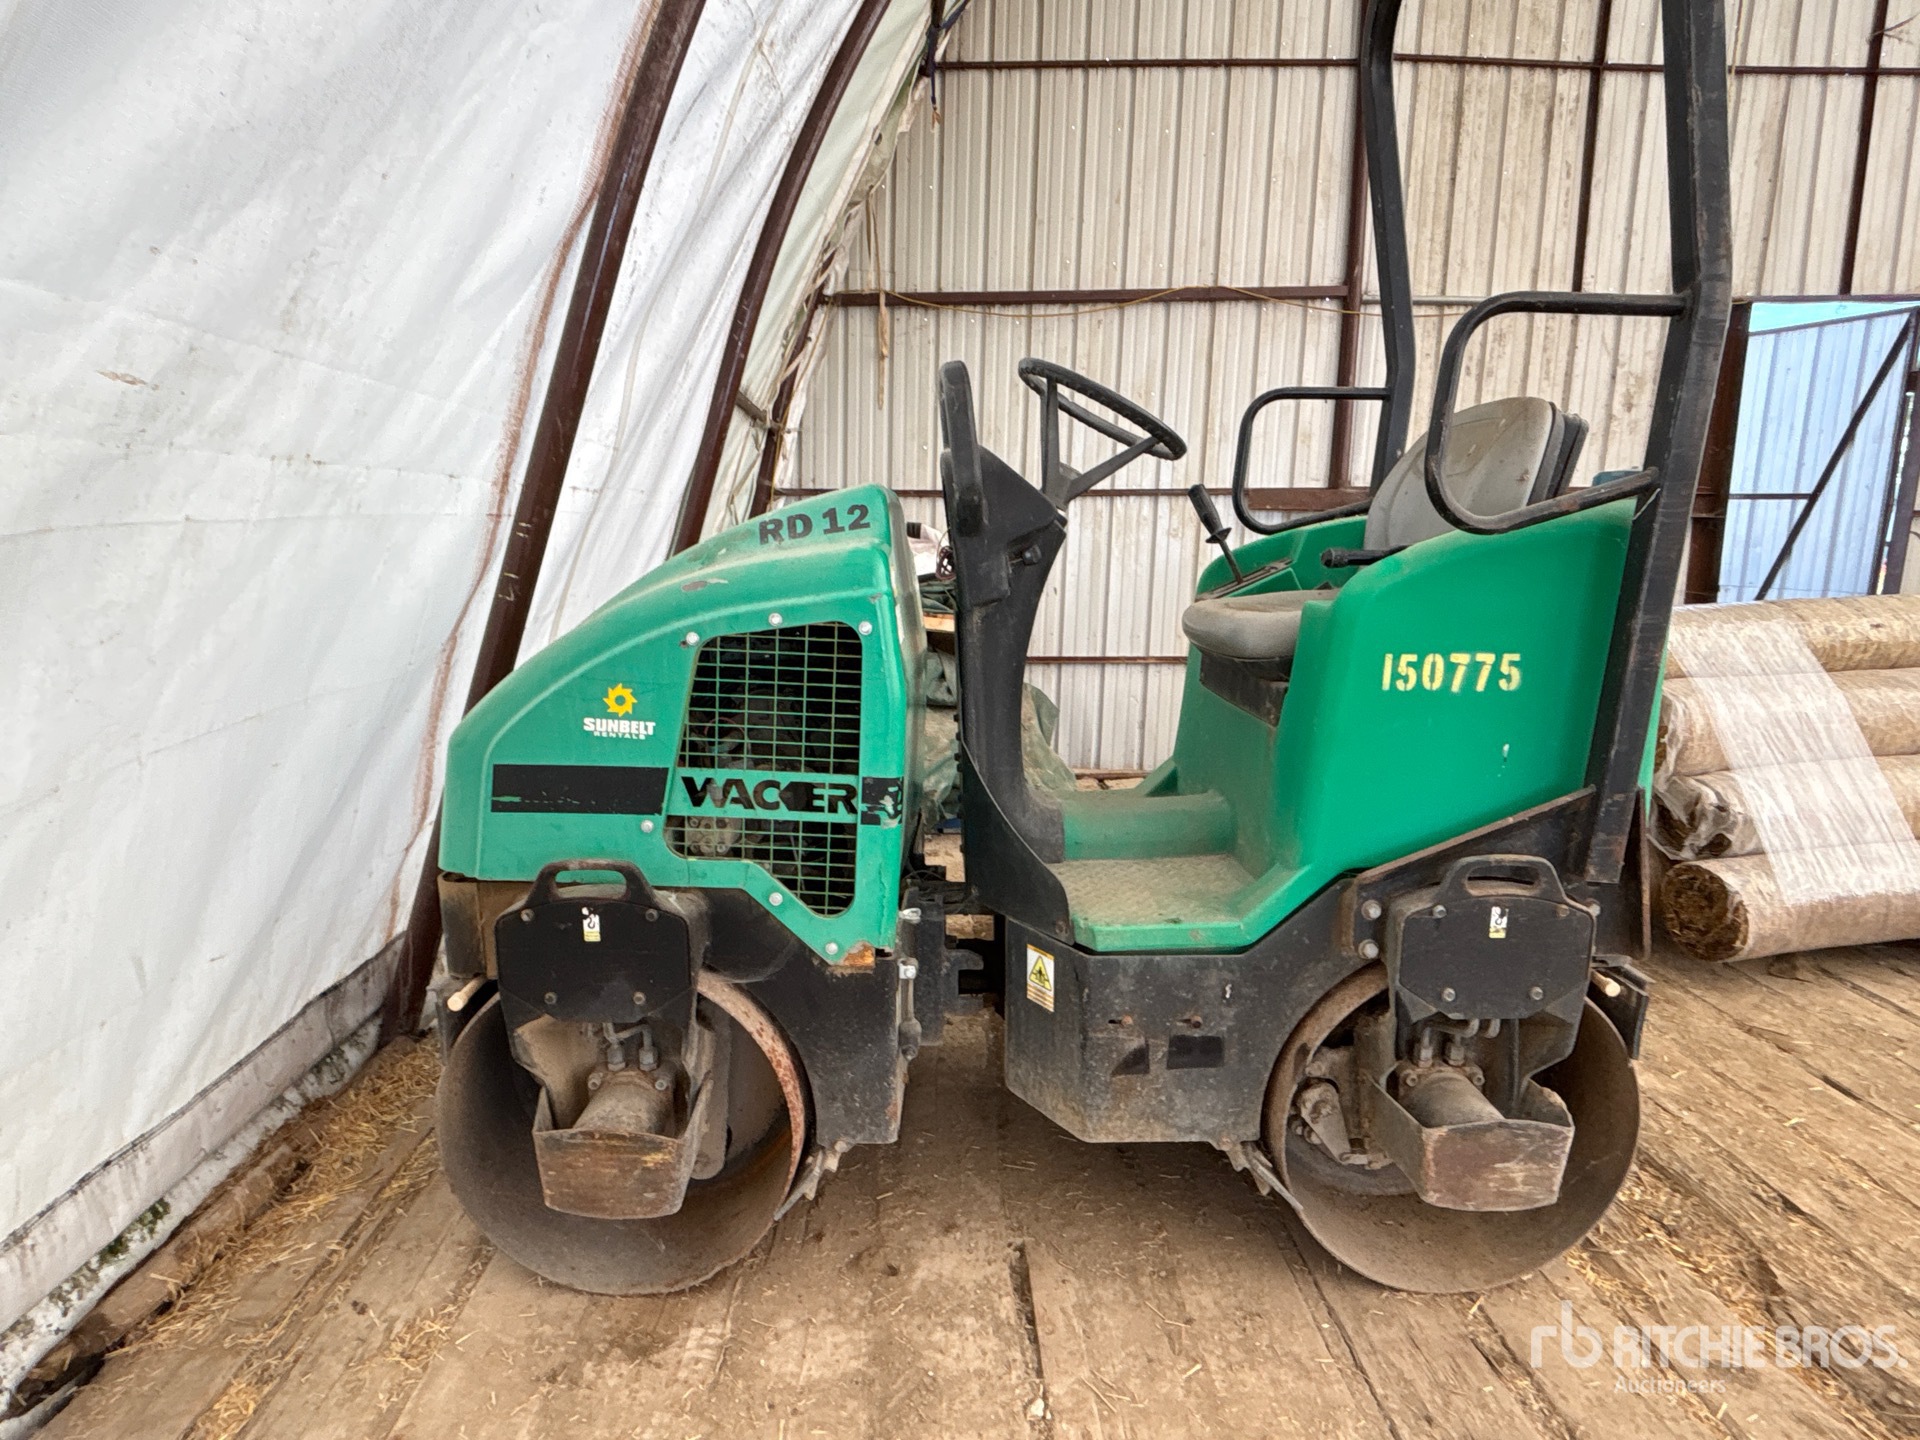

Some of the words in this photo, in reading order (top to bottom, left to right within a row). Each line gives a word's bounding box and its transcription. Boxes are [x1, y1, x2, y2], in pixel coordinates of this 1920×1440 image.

[759, 513, 813, 545] RD
[822, 504, 871, 534] 12
[1381, 652, 1522, 693] 150775
[583, 717, 656, 735] SUNBELT
[593, 731, 646, 740] RENTALS
[681, 775, 859, 815] WACKER
